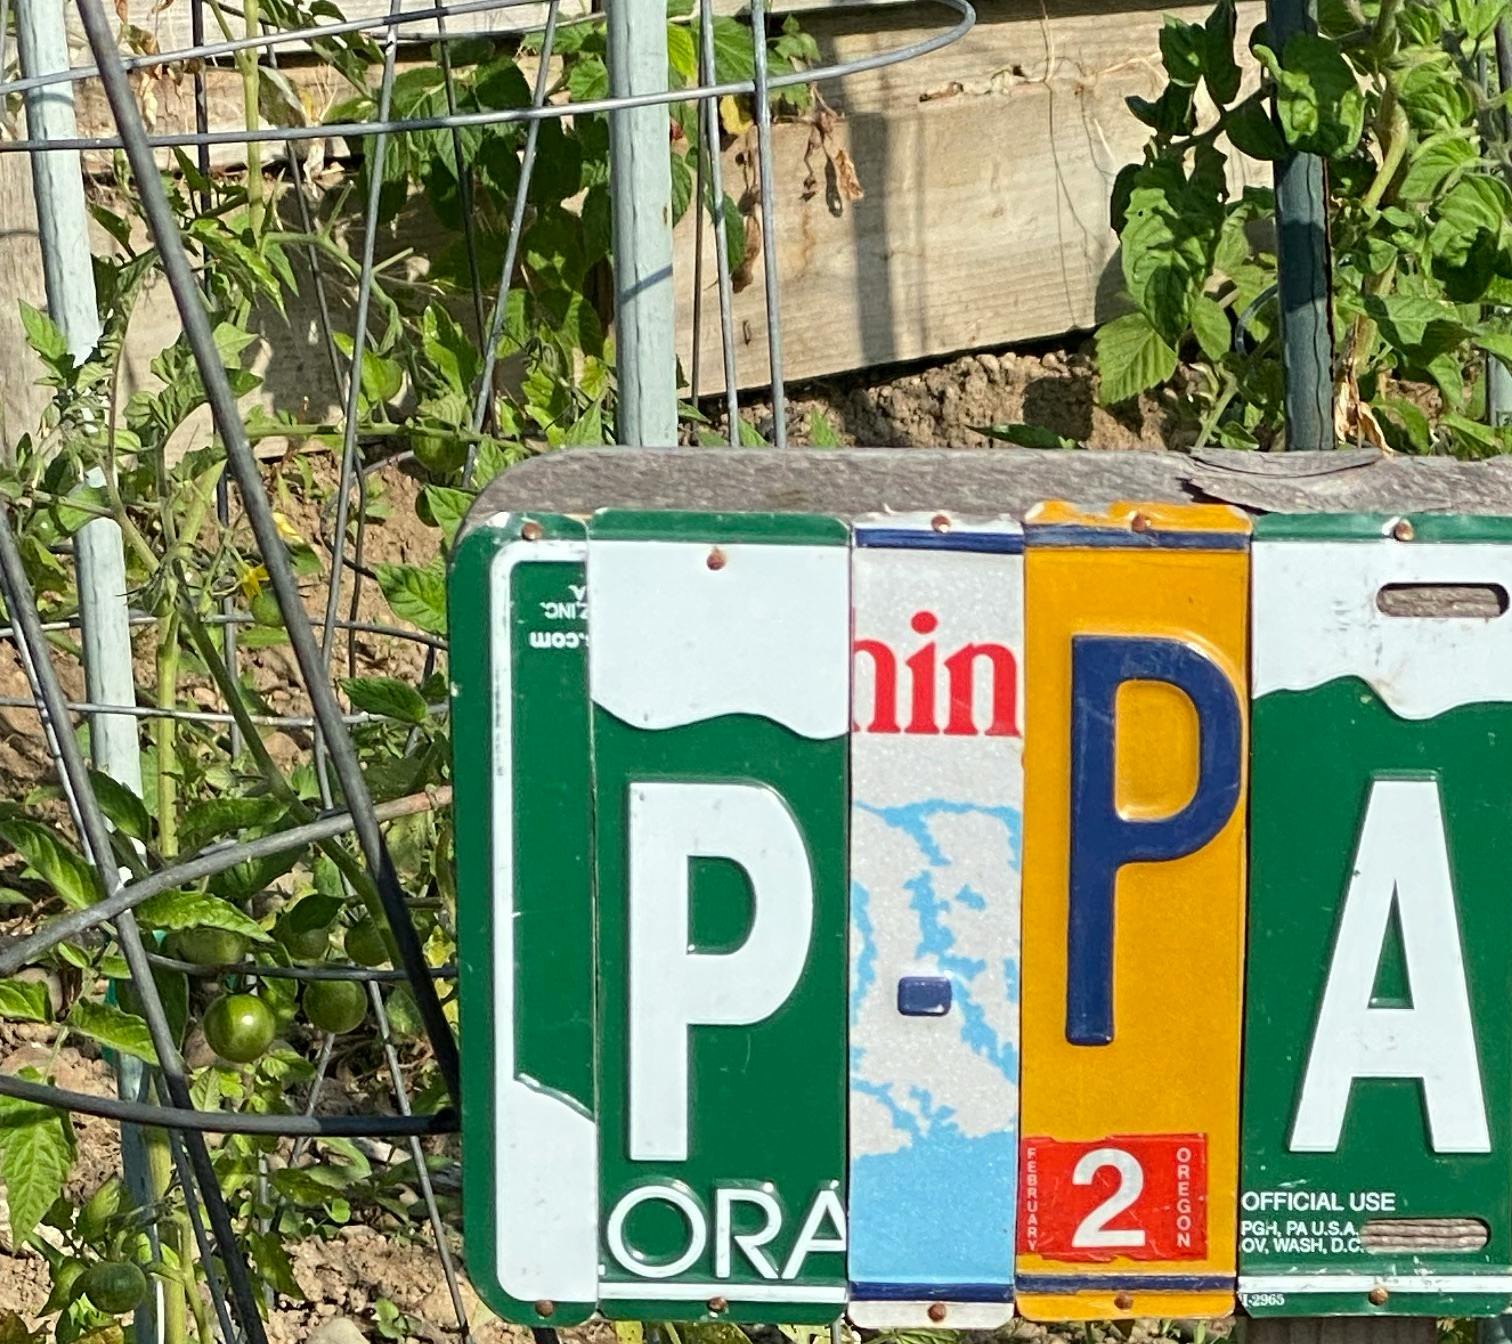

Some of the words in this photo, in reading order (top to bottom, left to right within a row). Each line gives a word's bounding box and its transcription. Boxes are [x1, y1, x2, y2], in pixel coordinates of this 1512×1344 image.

[599, 1184, 847, 1279] ORA
[1026, 1147, 1038, 1251] FEBRUARY
[1071, 1147, 1146, 1248] 2
[1176, 1147, 1191, 1248] OREGON
[1241, 1192, 1344, 1212] OFFICIAL
[1350, 1192, 1396, 1212] USE
[1287, 1221, 1308, 1237] PA
[1311, 1220, 1360, 1236] U.S.A.
[1274, 1237, 1327, 1254] WASH,
